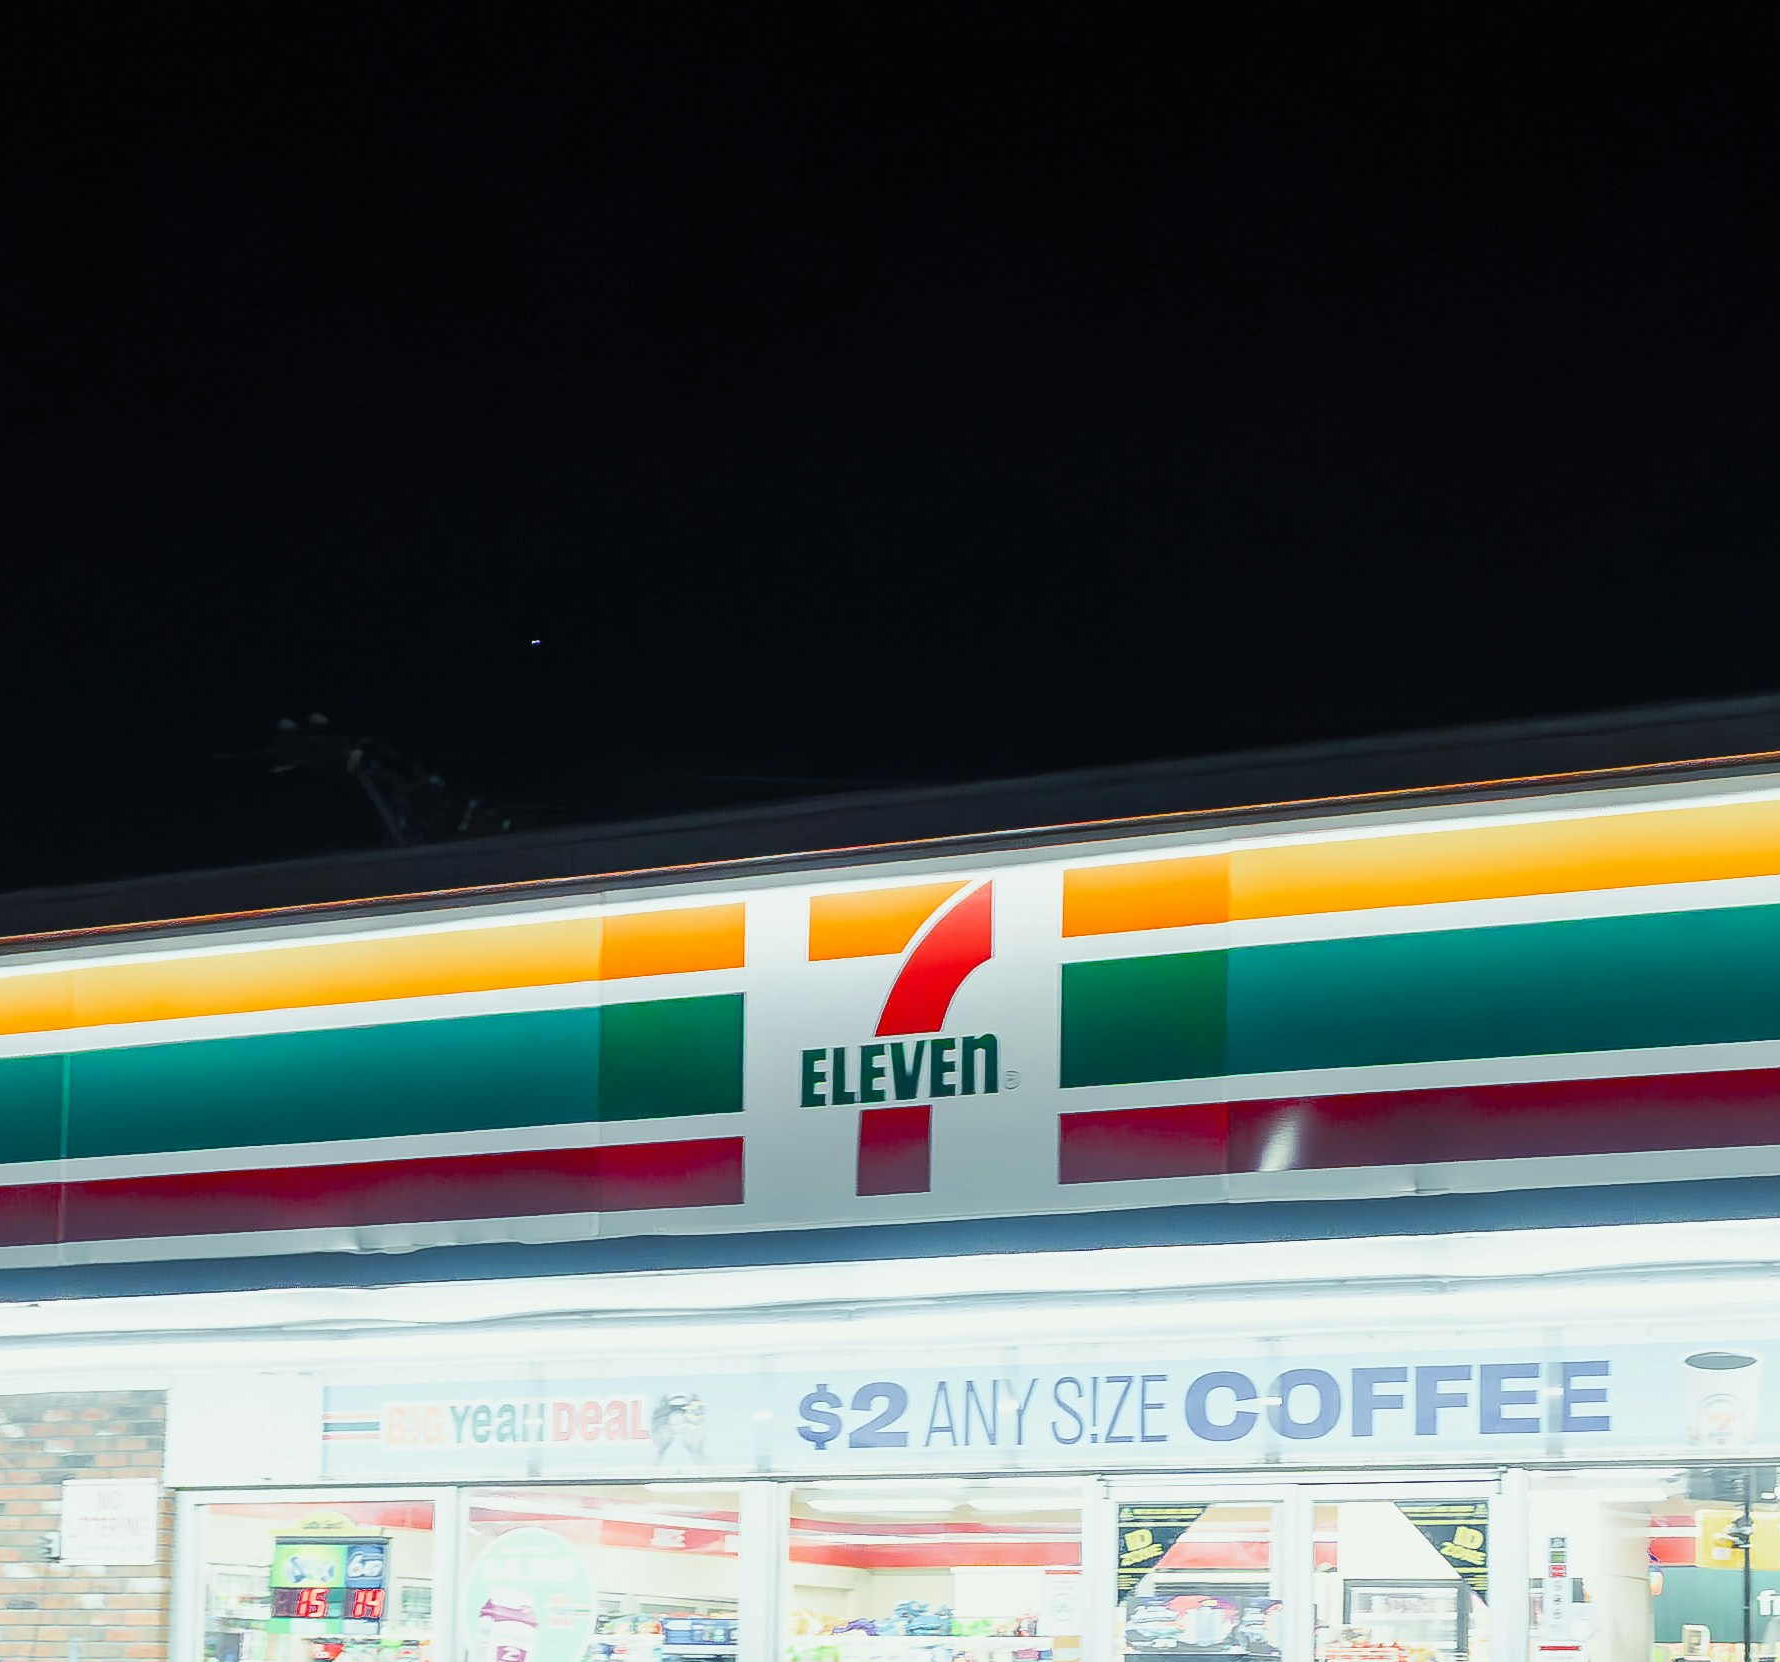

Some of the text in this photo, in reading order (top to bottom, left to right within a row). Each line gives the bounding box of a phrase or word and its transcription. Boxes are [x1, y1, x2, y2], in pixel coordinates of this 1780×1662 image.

[797, 1382, 909, 1450] $2
[925, 1378, 1039, 1447] ANY
[1185, 1360, 1611, 1442] COFFEE
[297, 1588, 329, 1618] 15
[353, 1589, 385, 1618] 14
